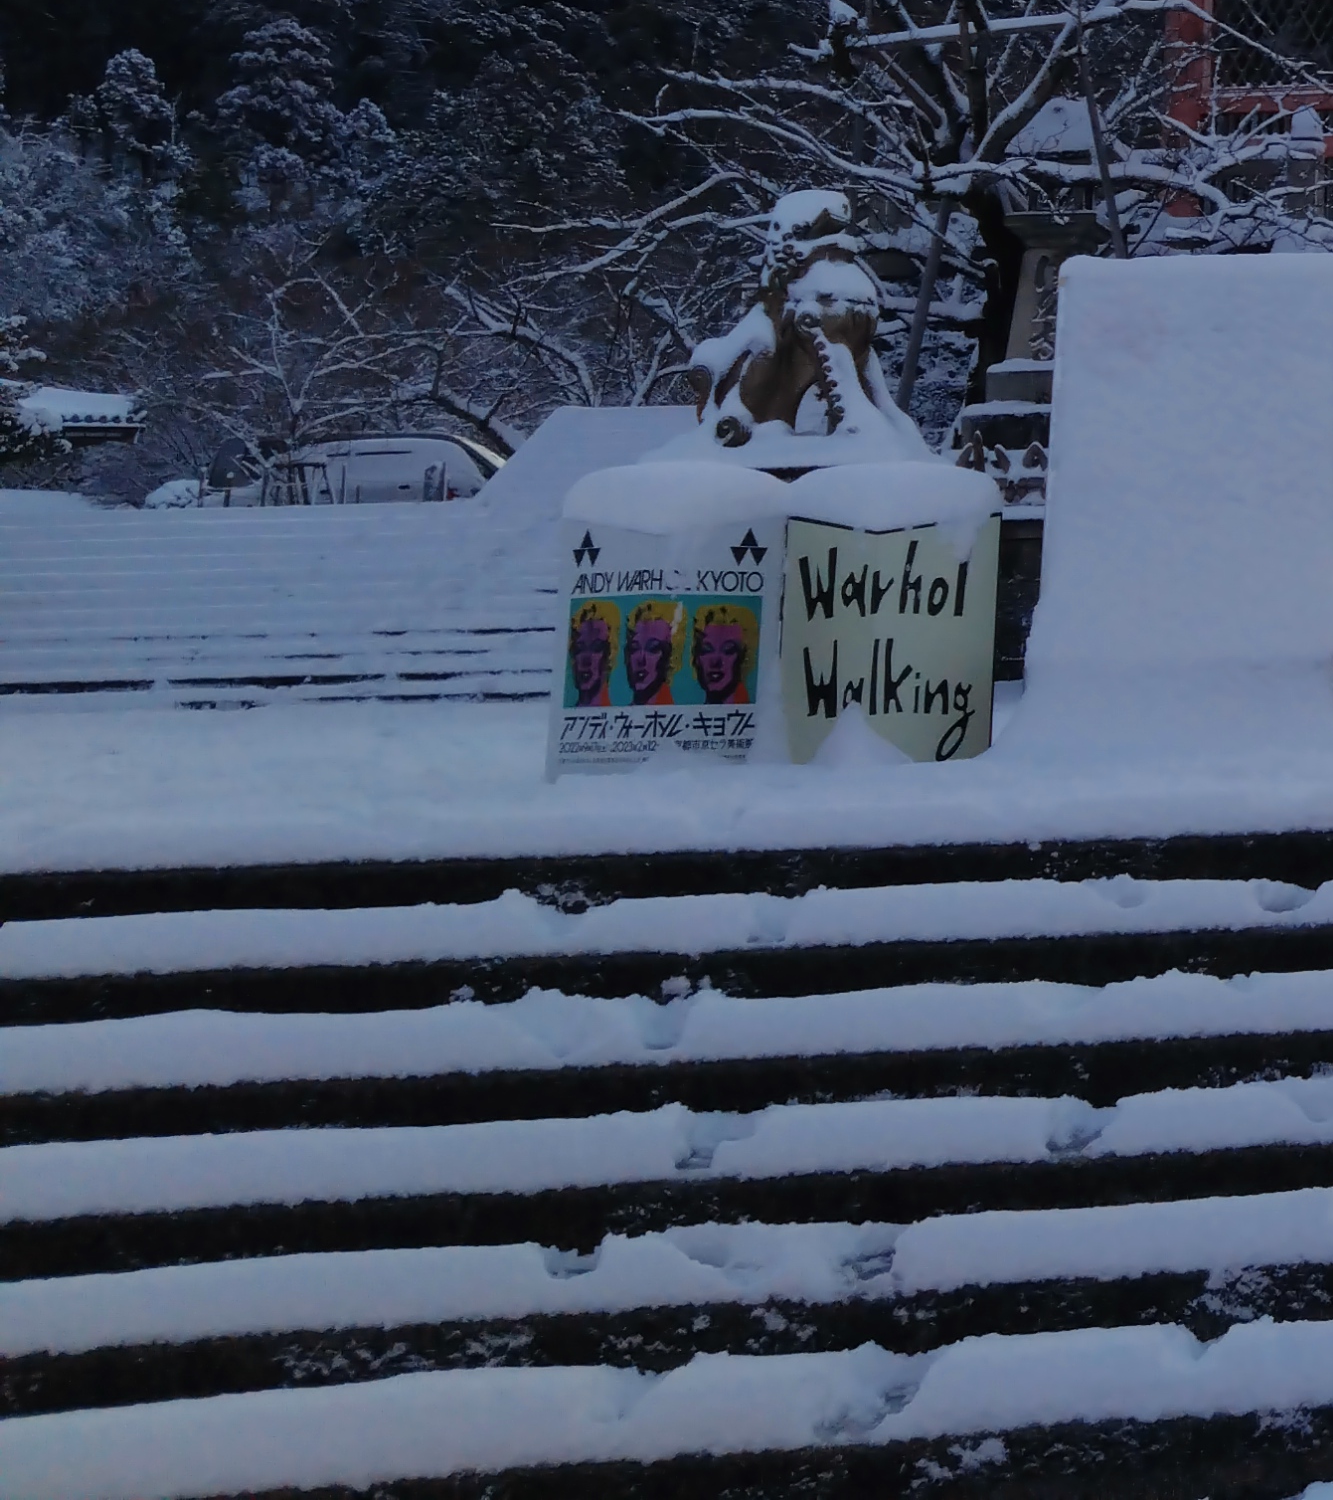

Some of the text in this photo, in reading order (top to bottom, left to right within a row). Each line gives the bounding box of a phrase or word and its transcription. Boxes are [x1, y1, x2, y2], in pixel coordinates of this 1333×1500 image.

[571, 569, 764, 595] ANDY WARH KYOTO
[799, 540, 969, 622] Warhol
[803, 637, 975, 762] Walking
